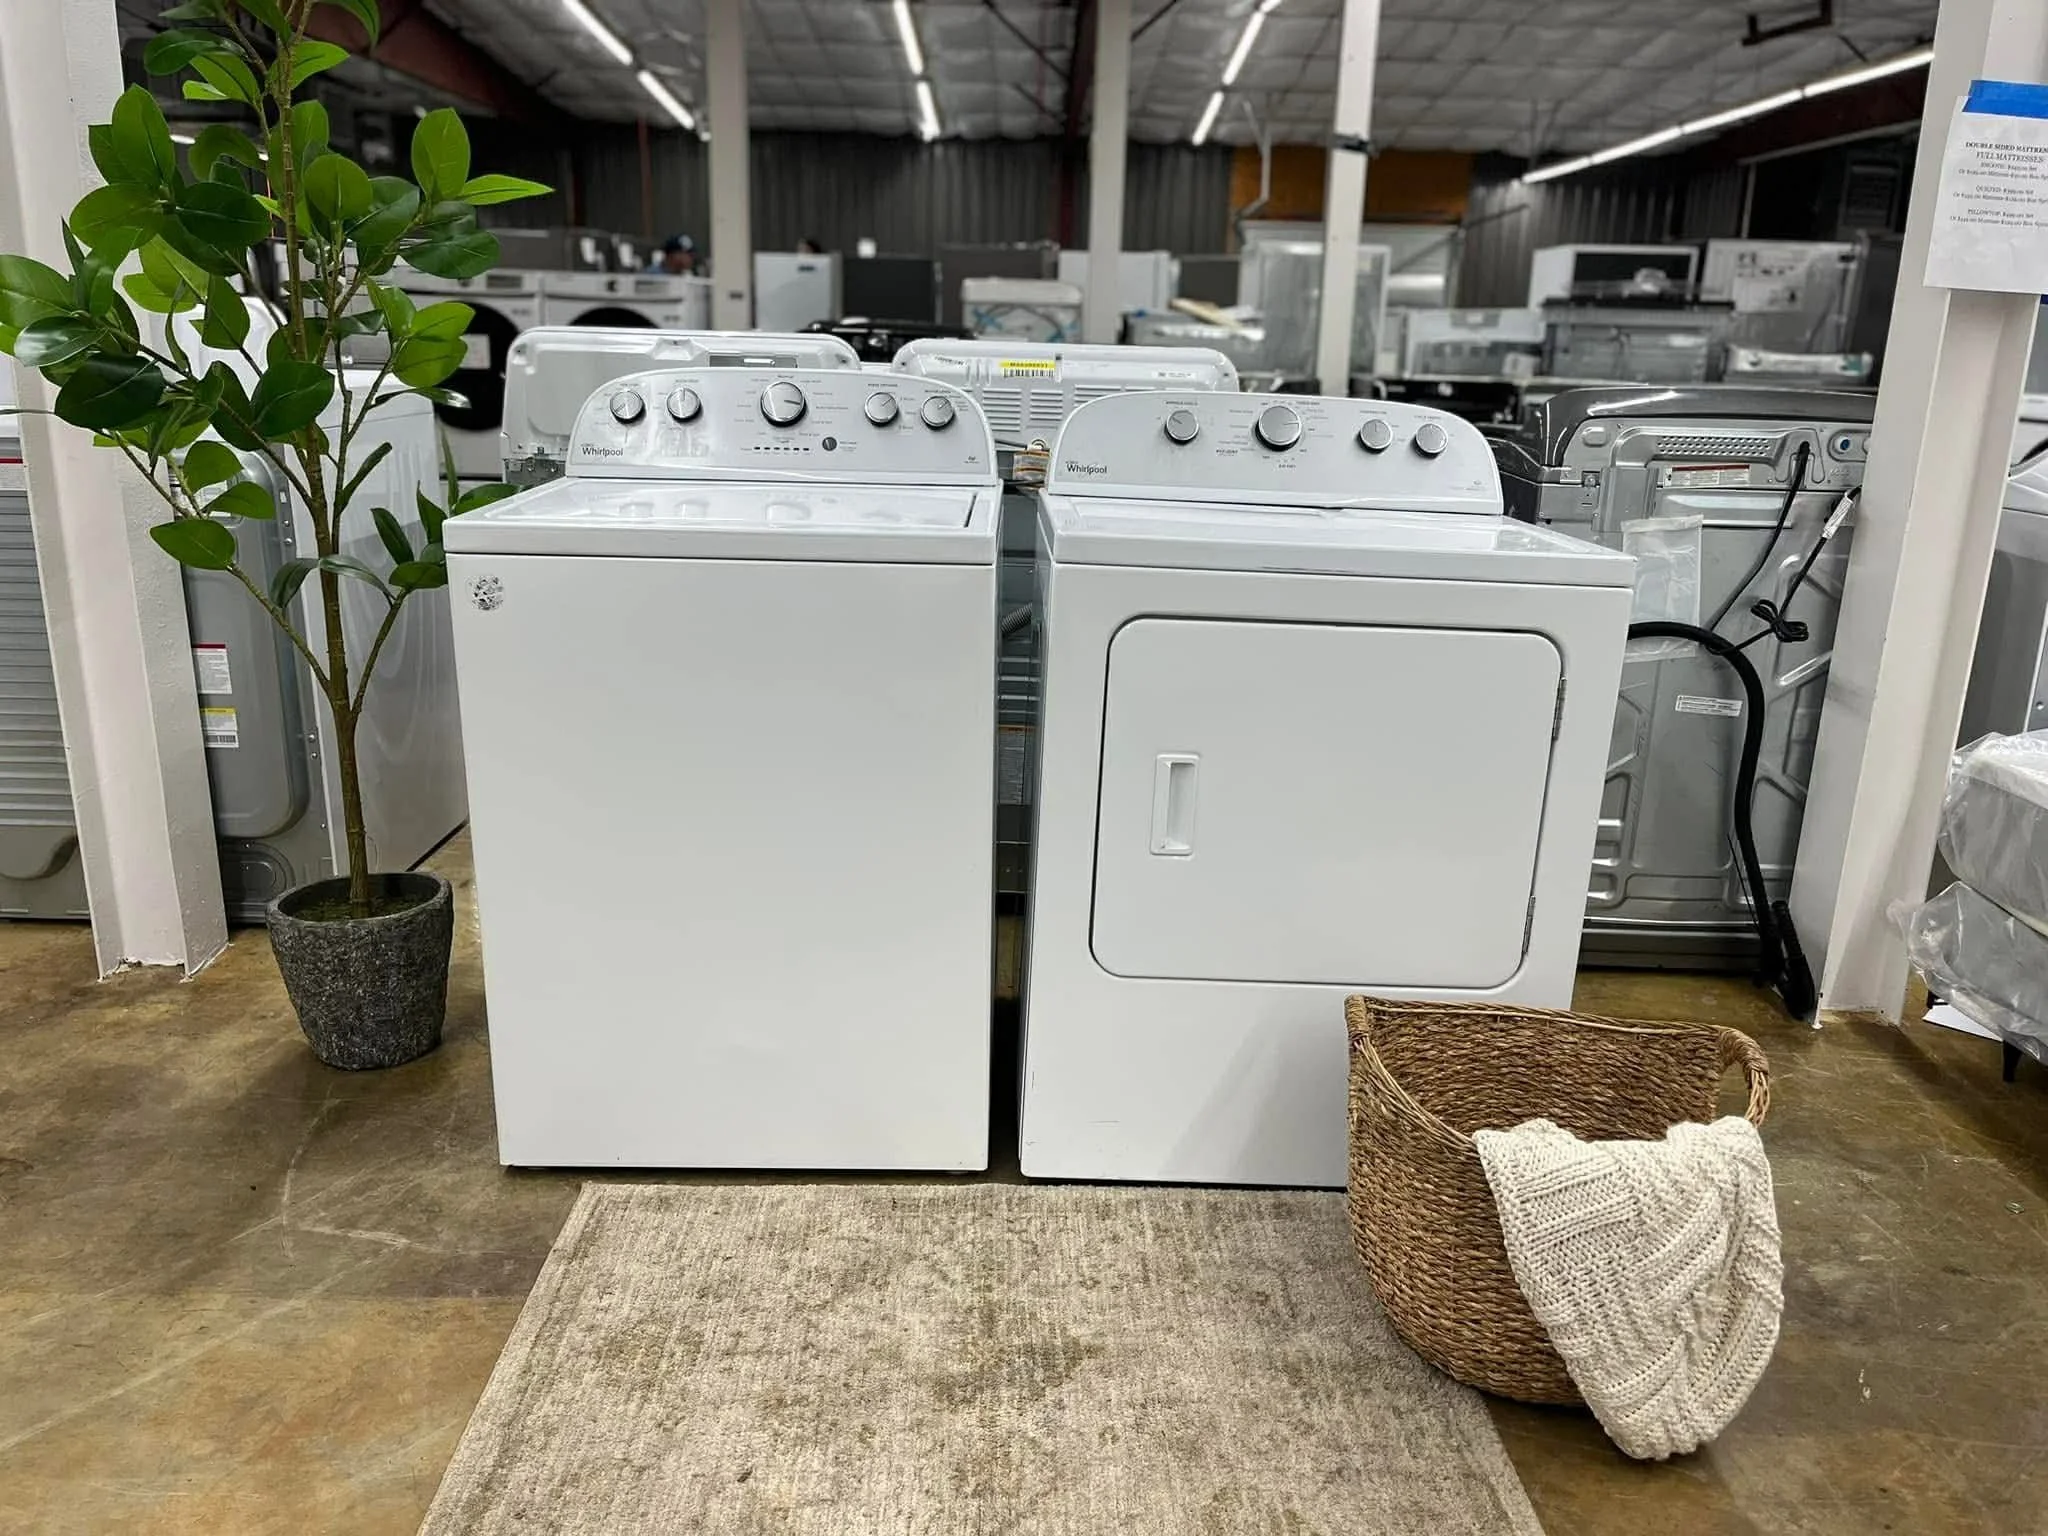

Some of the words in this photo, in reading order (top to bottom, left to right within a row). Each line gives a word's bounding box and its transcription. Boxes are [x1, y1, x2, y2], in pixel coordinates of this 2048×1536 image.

[1965, 141, 1993, 149] DOUBLE
[1995, 143, 2015, 151] SIDED
[1976, 151, 1994, 159] FULL
[582, 447, 623, 457] Whirlpool
[1066, 463, 1107, 475] Whirlpool
